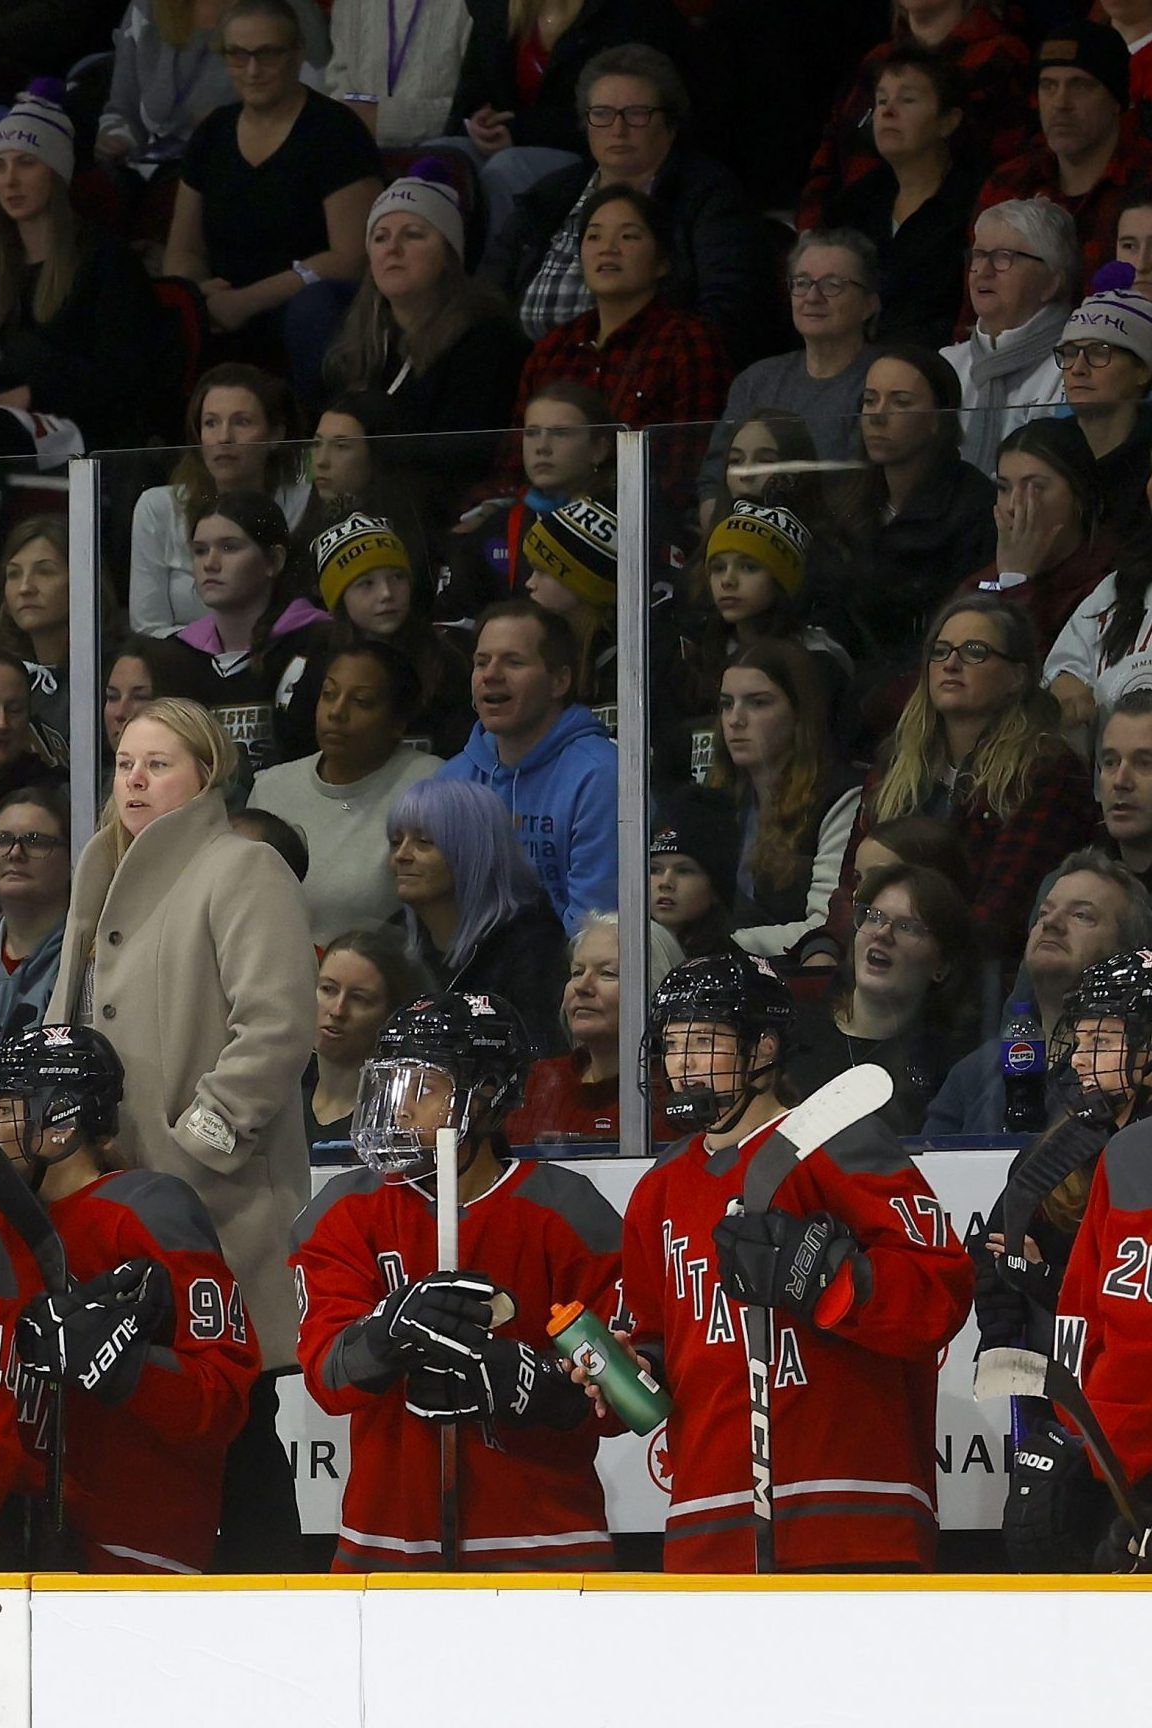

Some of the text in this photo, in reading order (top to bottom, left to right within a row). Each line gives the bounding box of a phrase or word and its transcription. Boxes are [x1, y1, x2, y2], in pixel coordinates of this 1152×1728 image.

[38, 1066, 80, 1076] BAUER
[50, 1105, 82, 1123] BAUER
[888, 1195, 948, 1248] 17
[1102, 1236, 1152, 1301] 2
[188, 1277, 248, 1345] 94
[749, 1357, 773, 1521] CCM
